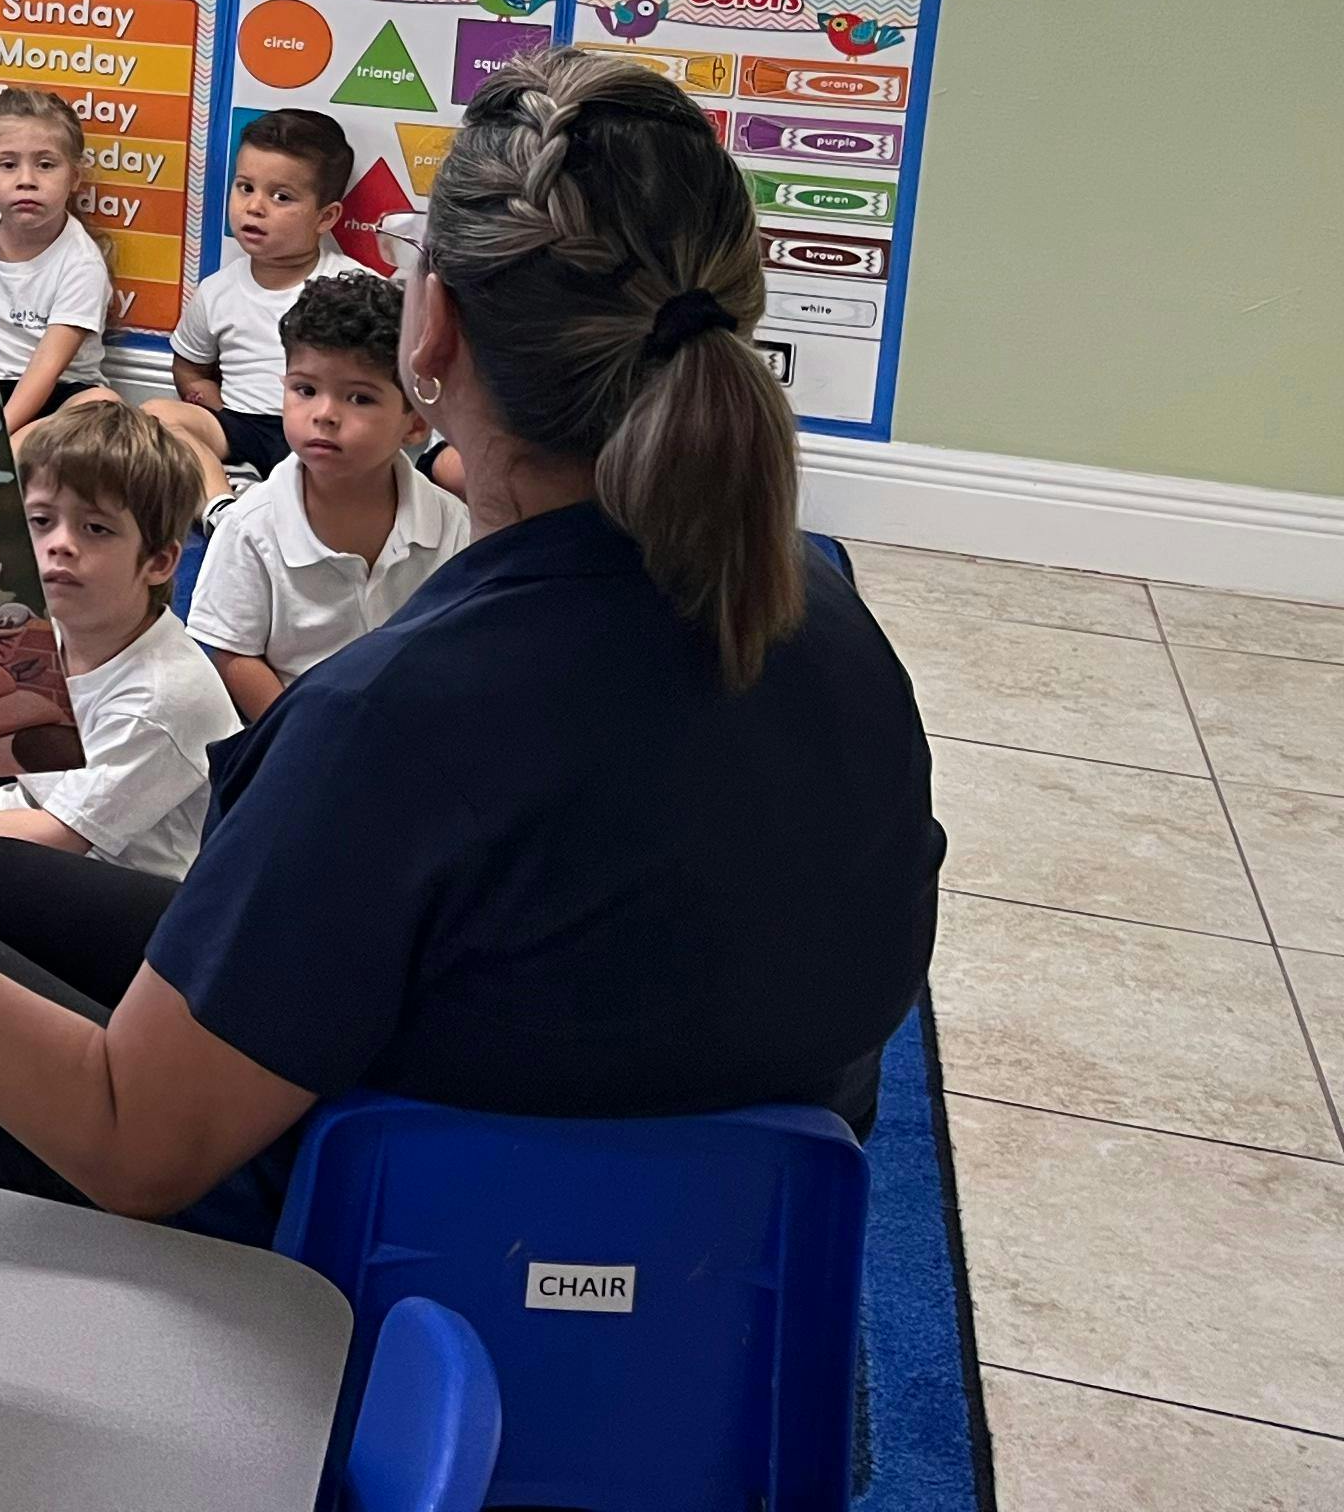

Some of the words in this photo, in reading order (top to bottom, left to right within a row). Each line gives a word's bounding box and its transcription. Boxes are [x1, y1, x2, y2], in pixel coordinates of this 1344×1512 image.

[264, 35, 305, 52] circle
[357, 65, 415, 84] triangle
[821, 78, 864, 92] orange
[817, 135, 857, 151] purple
[813, 193, 850, 206] green
[806, 248, 844, 262] brown
[800, 304, 832, 316] white
[539, 1276, 626, 1297] CHAIR
